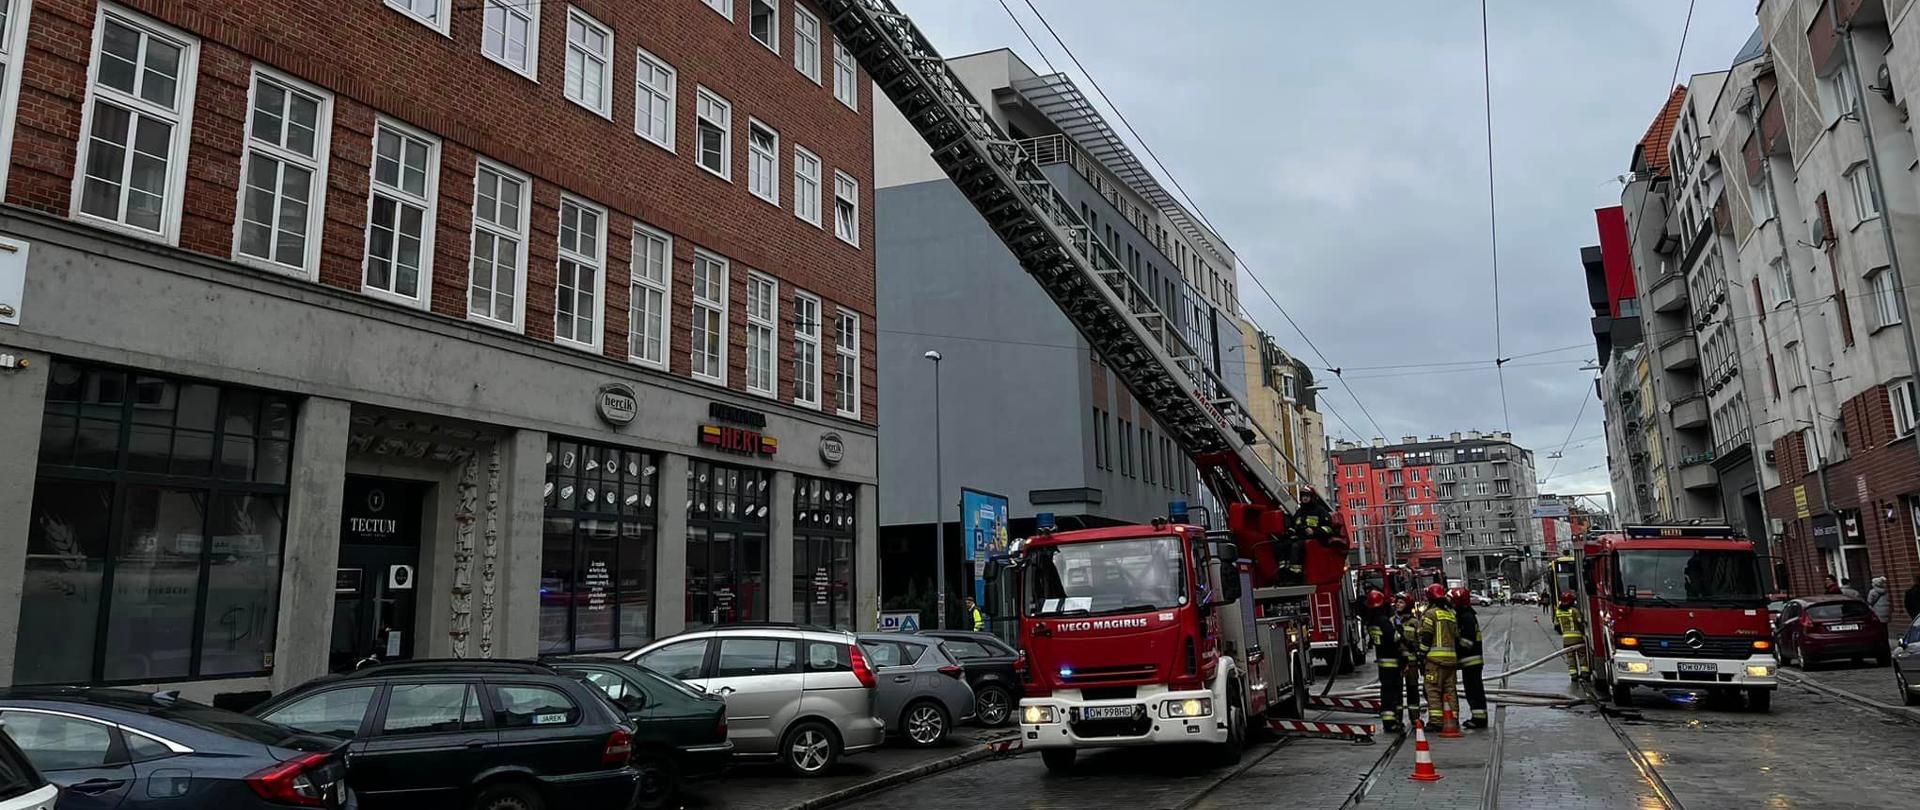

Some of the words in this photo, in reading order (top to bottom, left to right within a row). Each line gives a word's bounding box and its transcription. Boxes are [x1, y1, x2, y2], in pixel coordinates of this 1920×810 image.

[604, 394, 633, 411] hercik
[1192, 389, 1227, 429] MAGIRUS
[720, 426, 761, 454] HERT
[350, 517, 396, 534] TECTUM
[1057, 622, 1090, 632] IVECO
[1094, 618, 1147, 630] MAGIRUS
[1090, 707, 1102, 718] DW
